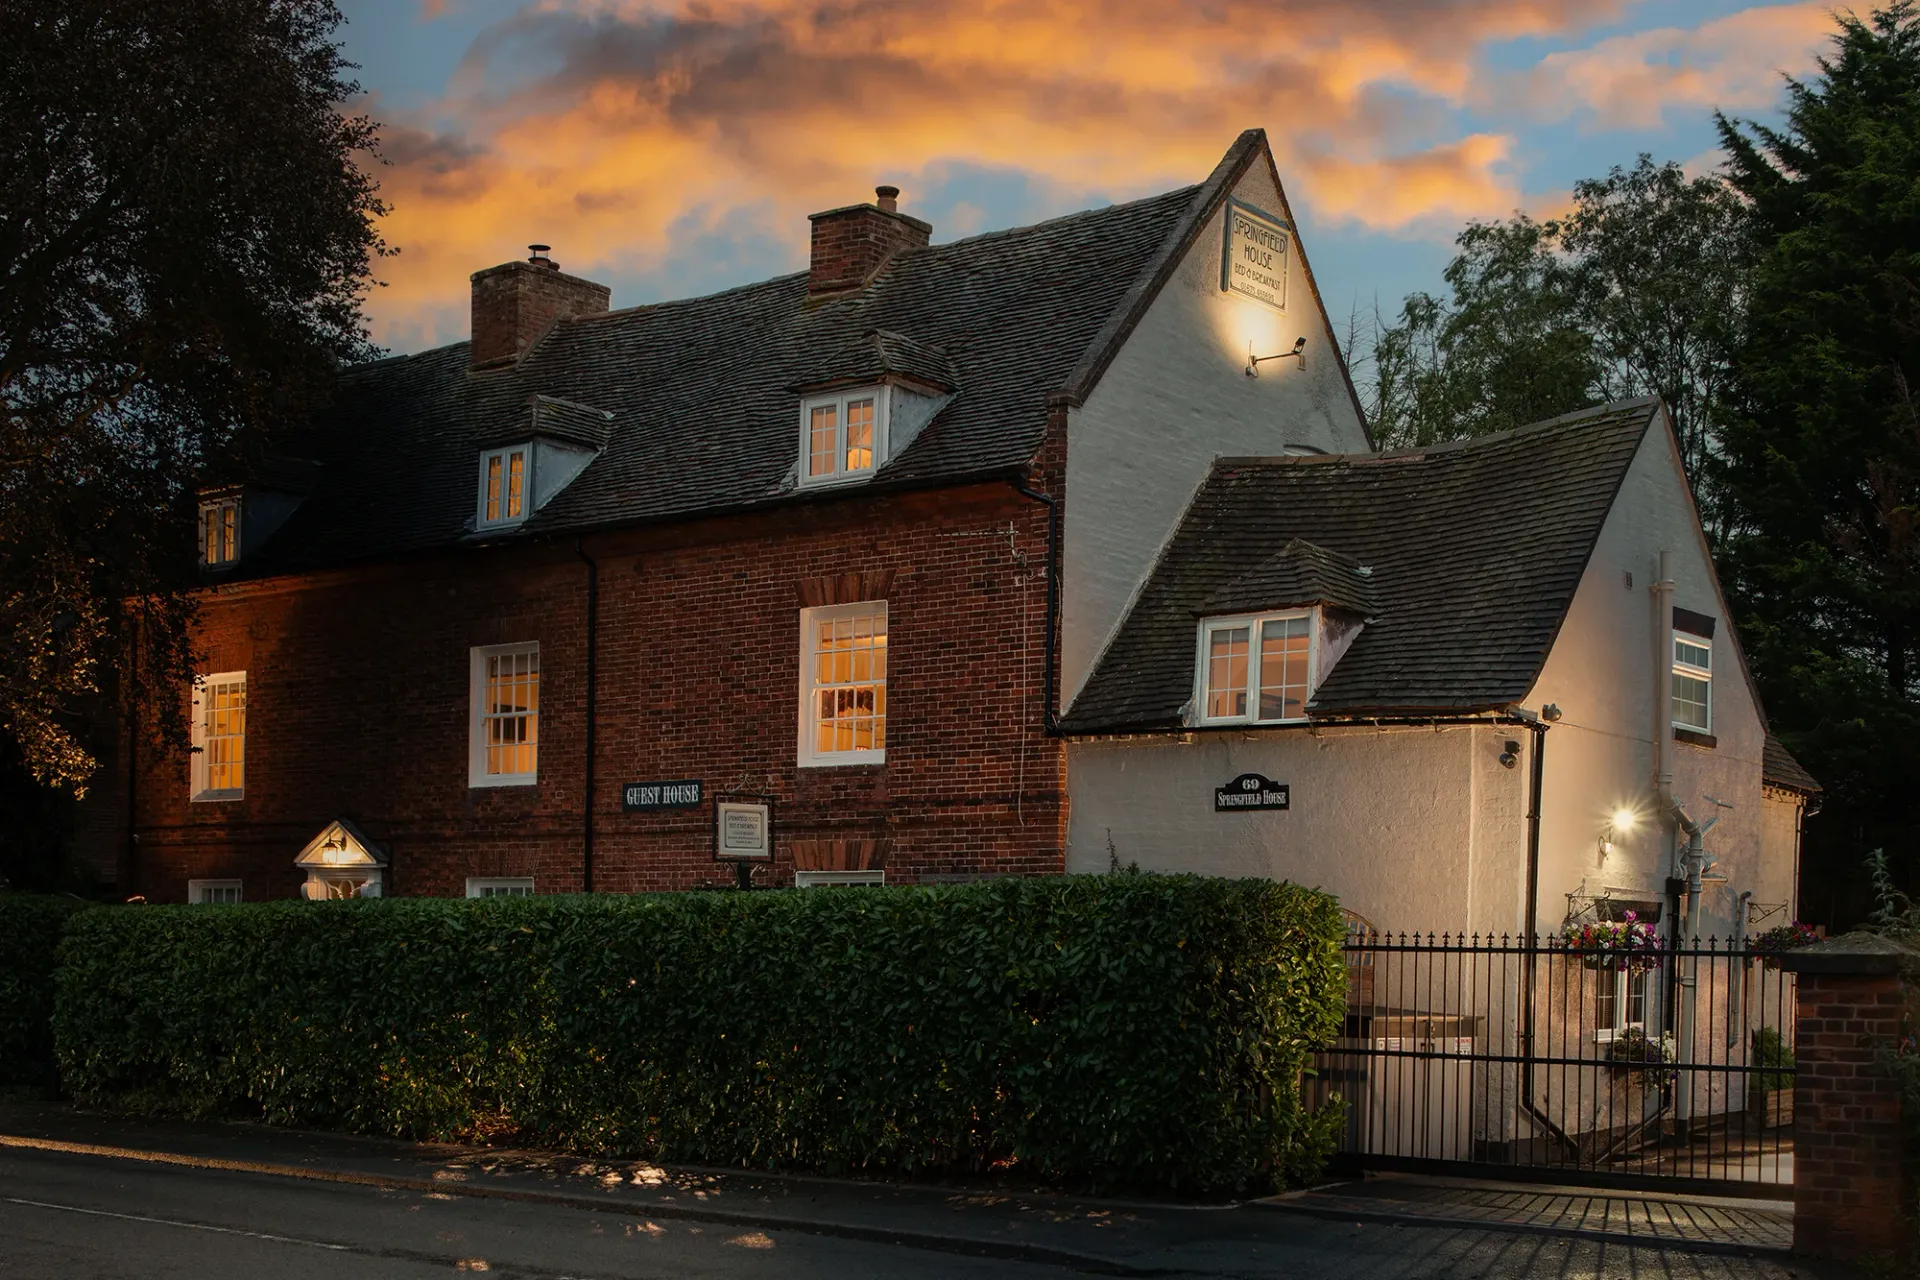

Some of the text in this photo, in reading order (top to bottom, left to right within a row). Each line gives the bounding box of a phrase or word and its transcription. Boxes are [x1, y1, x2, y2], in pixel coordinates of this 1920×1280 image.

[1234, 217, 1285, 254] SPRINGFIELD
[1244, 244, 1273, 271] HOUSE
[1234, 262, 1246, 277] BED
[1252, 270, 1281, 291] BREAKFAST
[626, 784, 699, 806] GUEST HOUSE
[1242, 778, 1261, 790] 69
[1263, 789, 1287, 804] HOUSE
